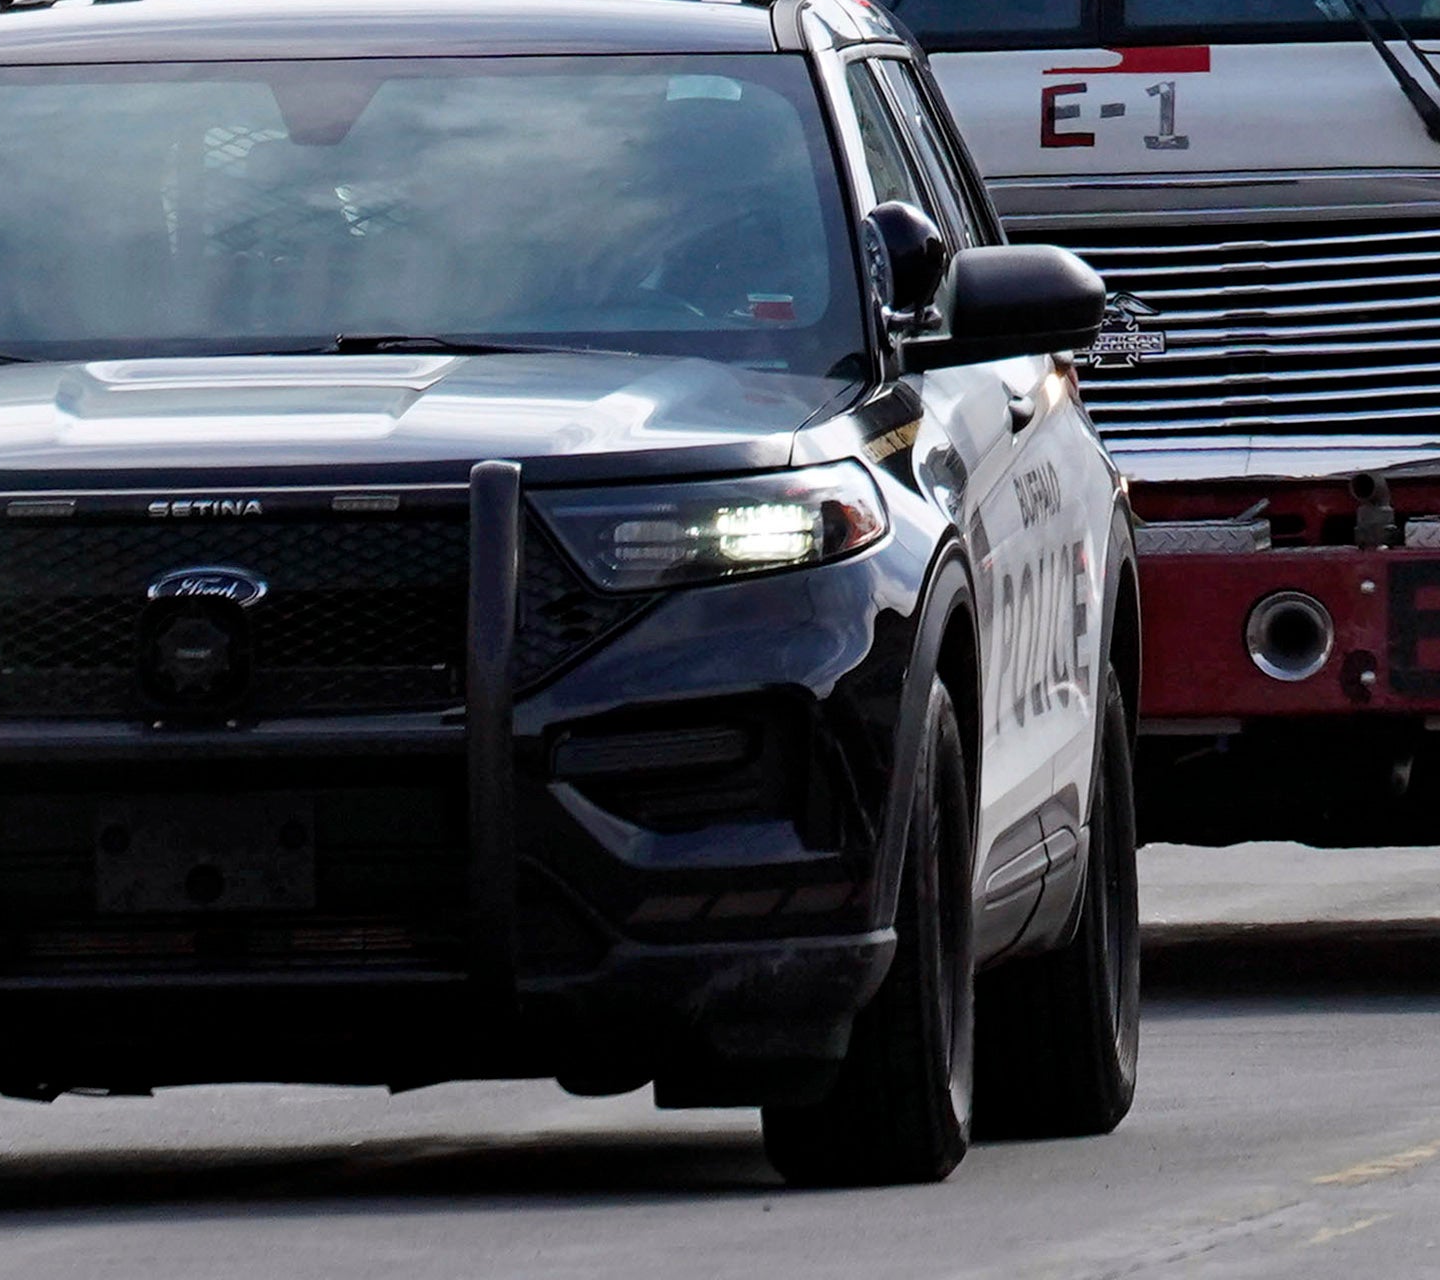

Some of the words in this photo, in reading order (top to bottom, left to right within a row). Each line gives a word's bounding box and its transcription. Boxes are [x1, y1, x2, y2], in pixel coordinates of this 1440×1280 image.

[1040, 81, 1190, 150] E-1
[147, 498, 264, 518] SETINA
[1012, 460, 1062, 530] BUFFALO
[995, 540, 1090, 735] POLICE
